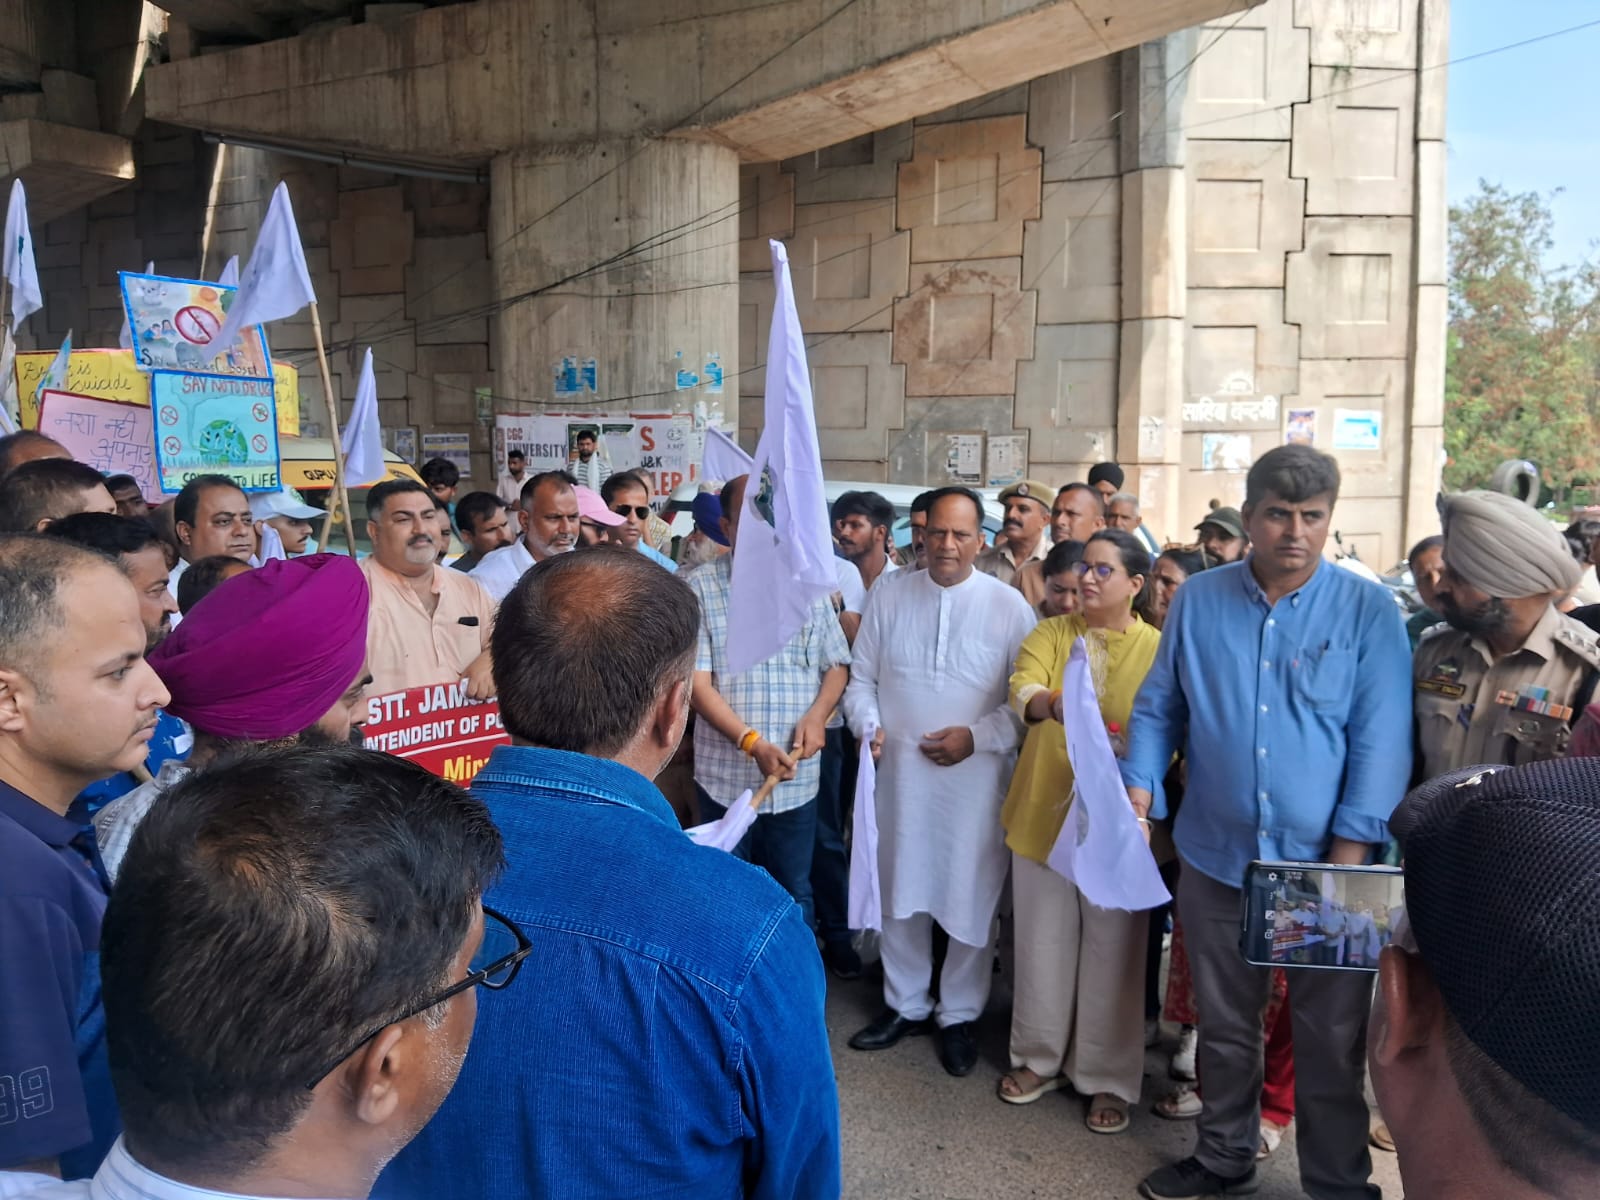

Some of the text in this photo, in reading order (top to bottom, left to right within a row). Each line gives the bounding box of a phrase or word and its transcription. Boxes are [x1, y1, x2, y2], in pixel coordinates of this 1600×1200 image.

[77, 360, 92, 375] is
[182, 376, 207, 394] SAY
[507, 427, 523, 441] CGC
[641, 456, 663, 468] J&K
[251, 472, 277, 487] LIFE
[459, 714, 481, 736] OF
